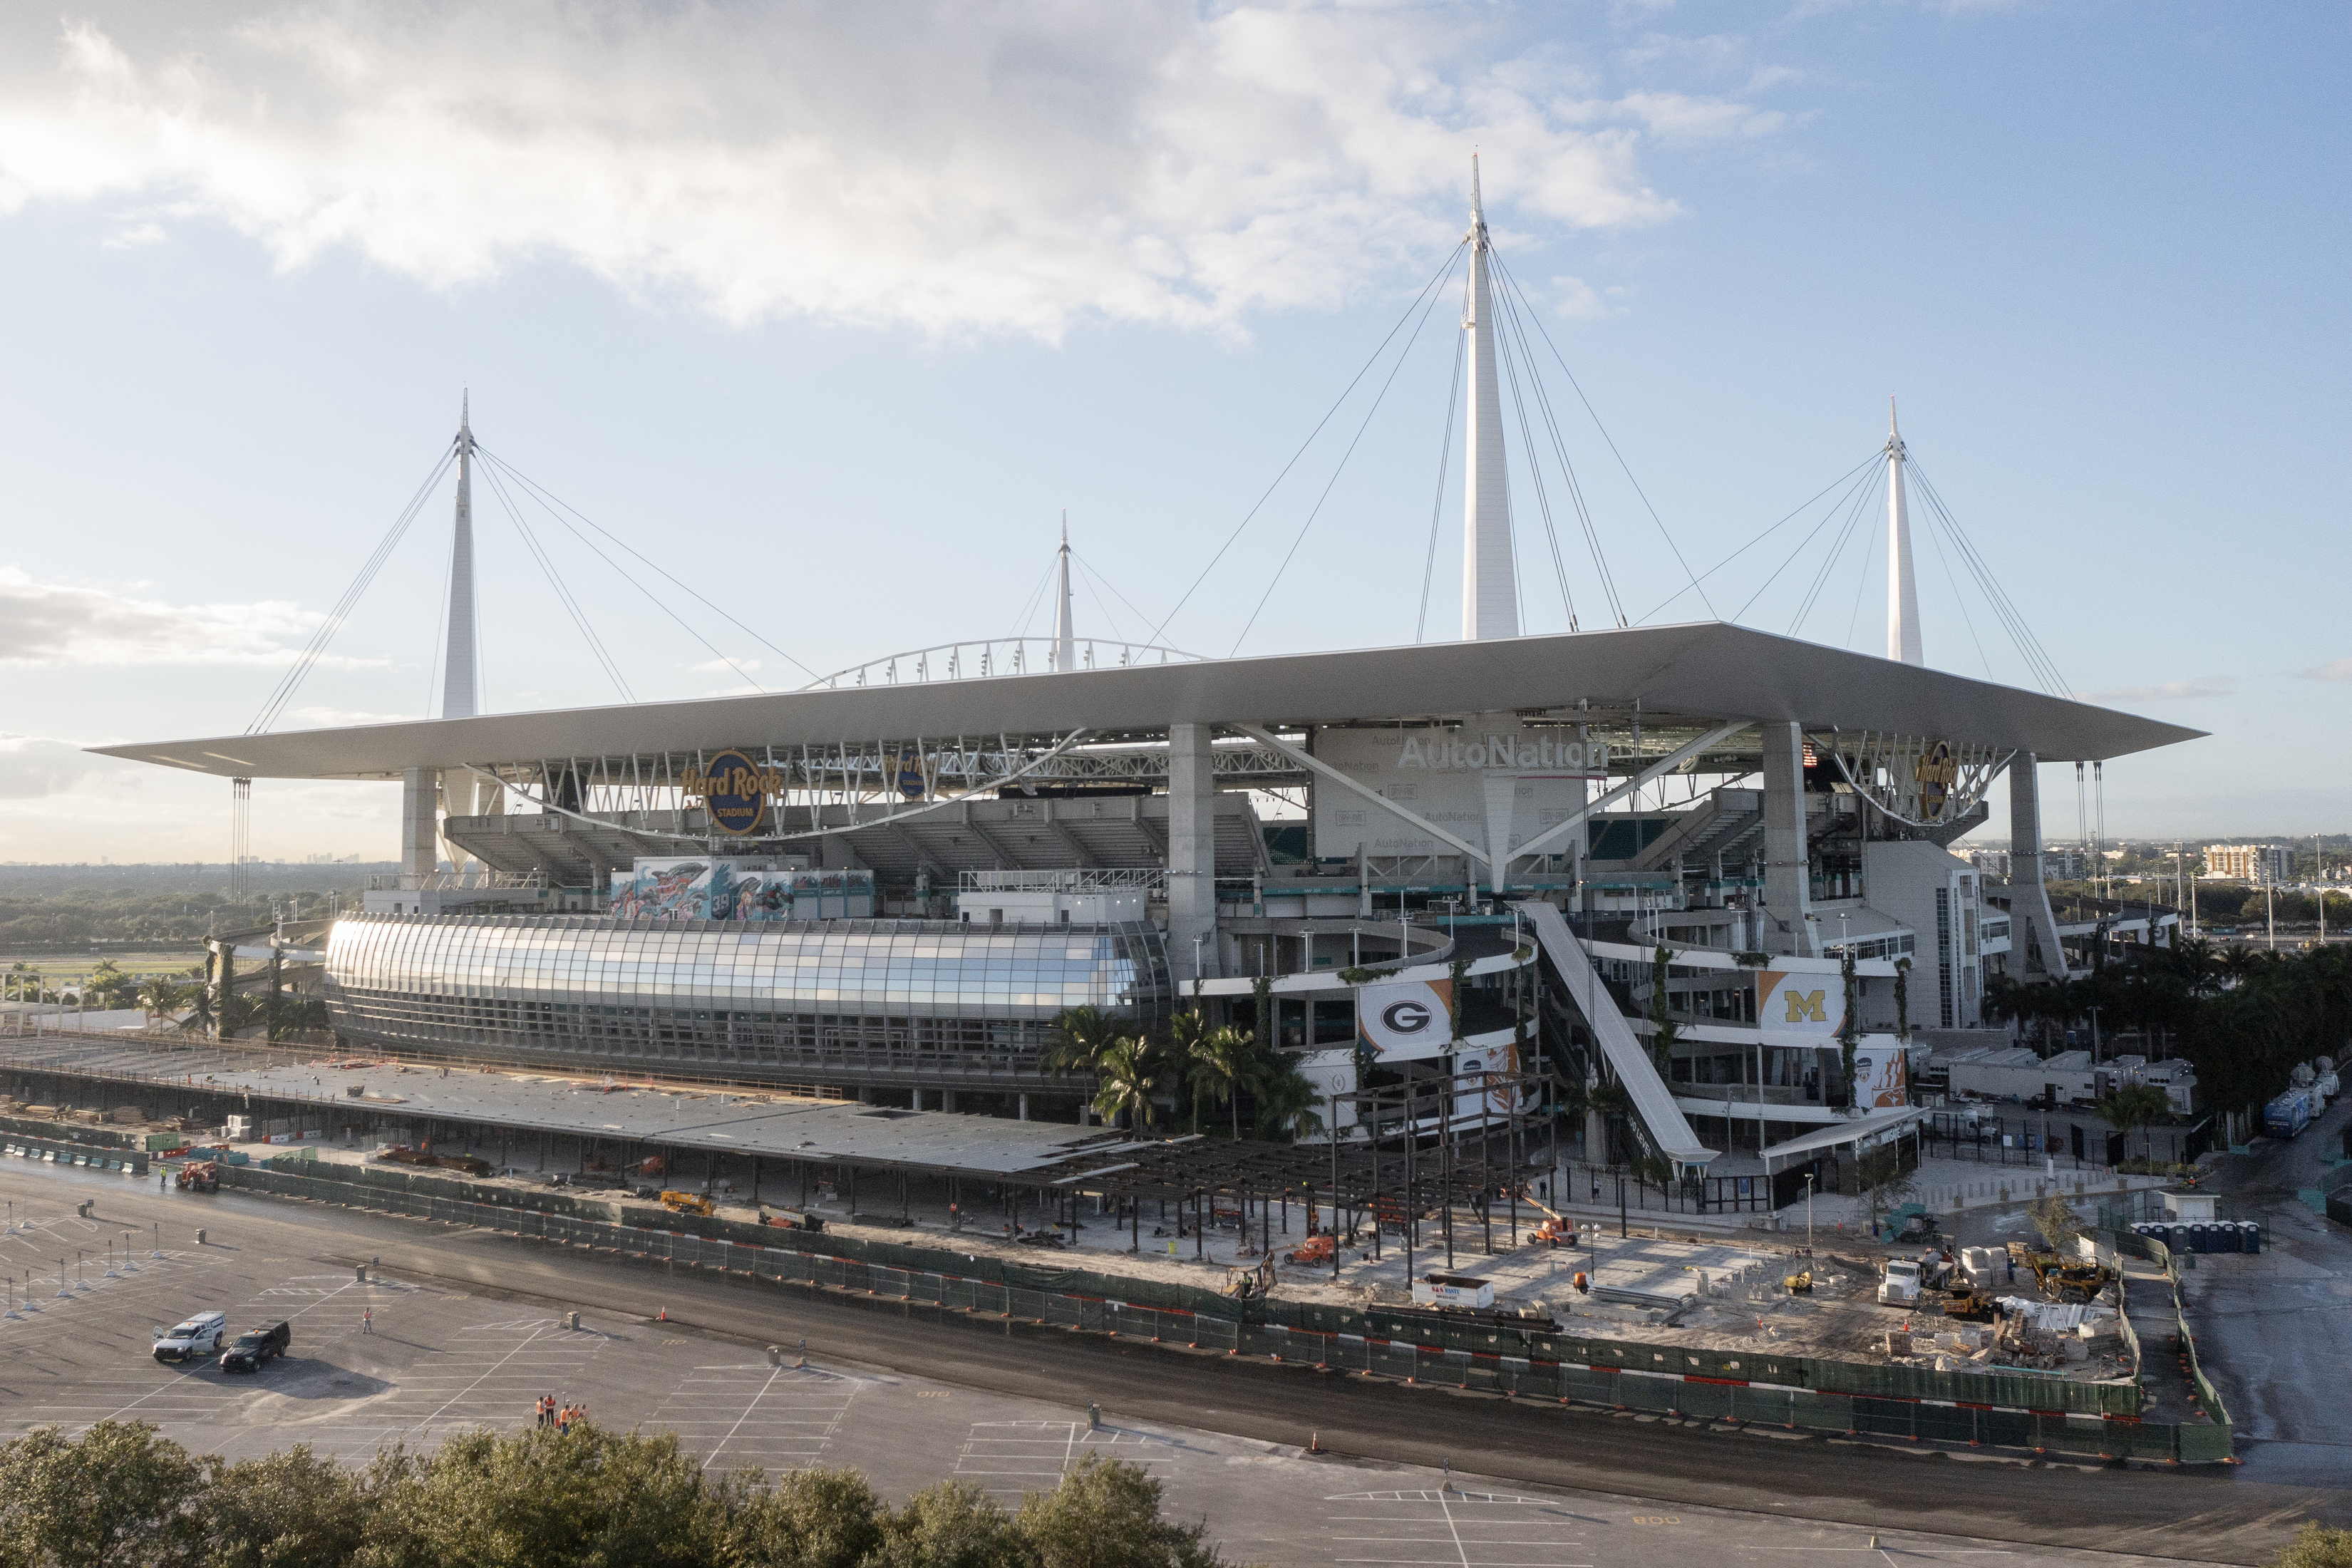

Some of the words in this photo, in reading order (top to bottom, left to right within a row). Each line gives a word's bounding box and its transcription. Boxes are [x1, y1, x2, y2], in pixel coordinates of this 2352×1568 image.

[1398, 735, 1609, 769] AutoNation
[681, 768, 731, 796] Hard
[732, 767, 783, 801] Rock
[717, 808, 754, 817] STADIUM
[1374, 838, 1433, 848] AutoNation
[713, 894, 729, 911] 39
[1383, 1003, 1430, 1033] G
[1785, 990, 1826, 1022] M
[1626, 1112, 1636, 1131] 300
[1636, 1128, 1651, 1159] LEVEL
